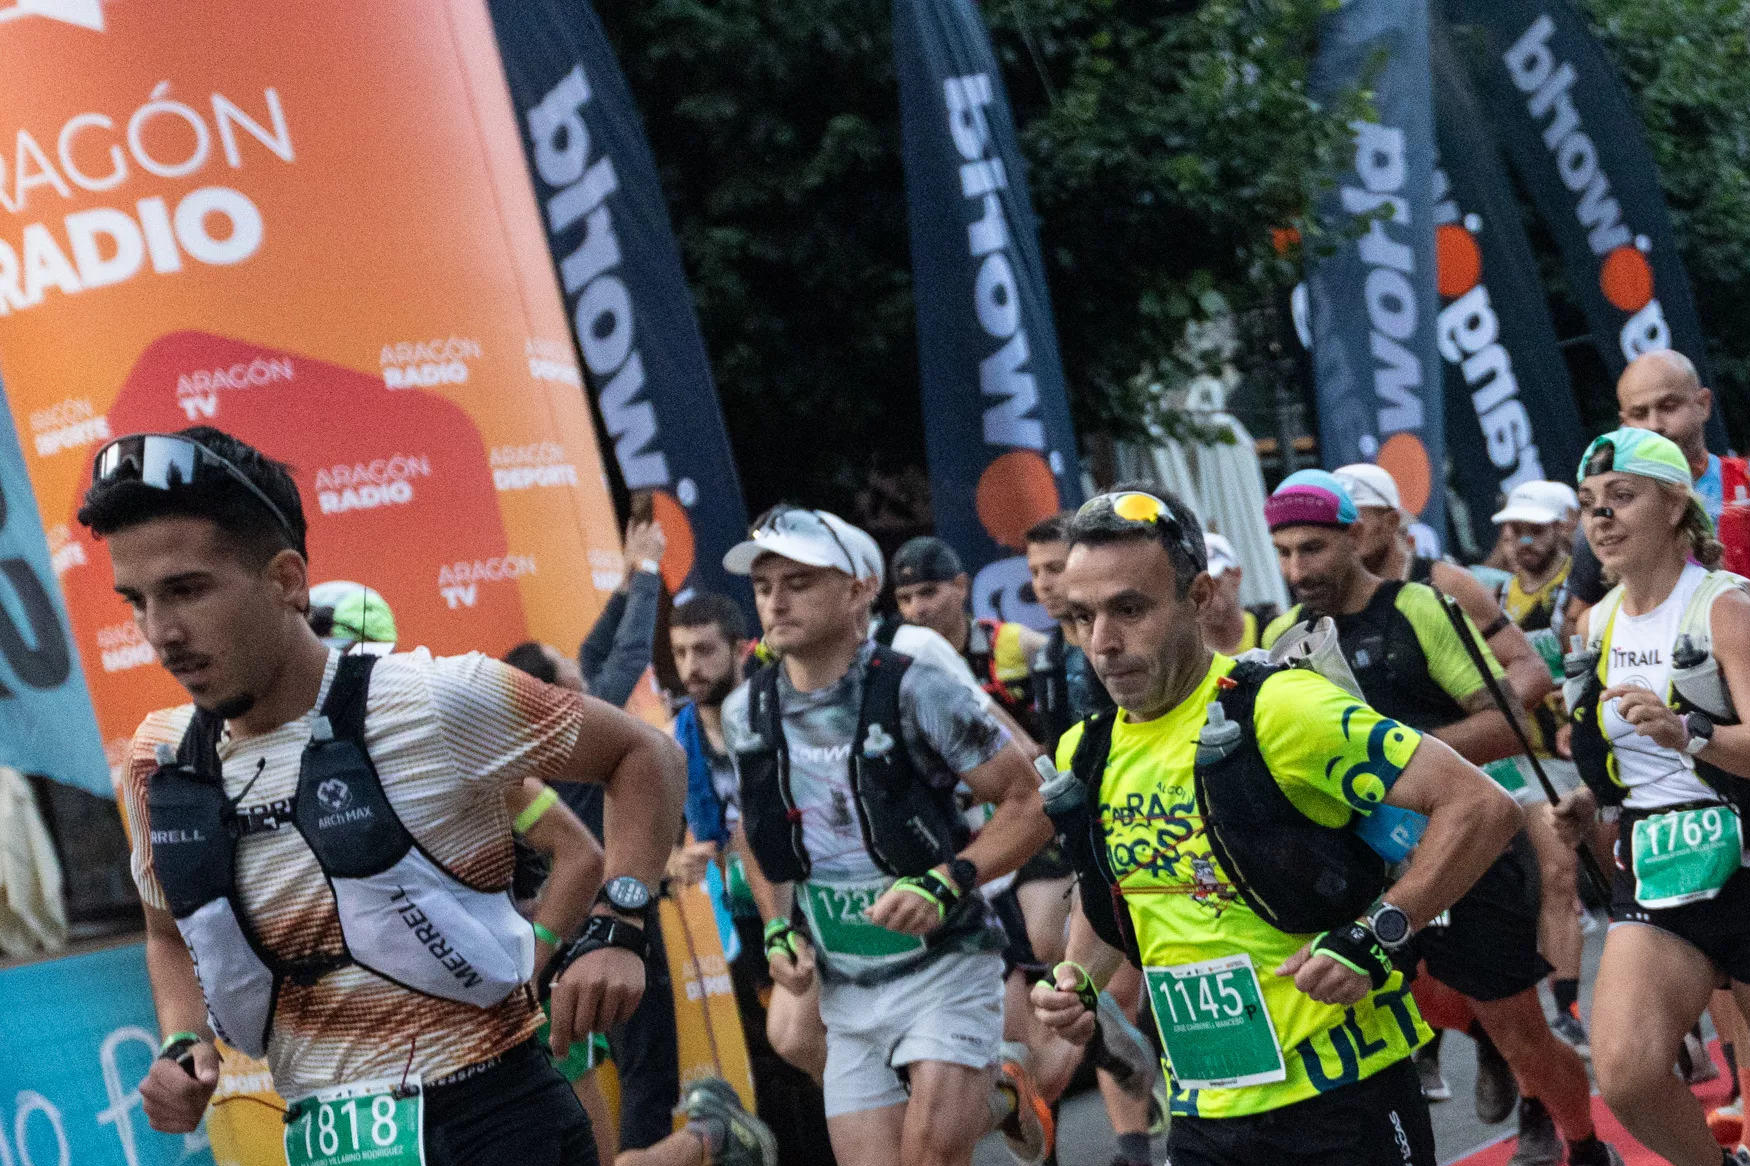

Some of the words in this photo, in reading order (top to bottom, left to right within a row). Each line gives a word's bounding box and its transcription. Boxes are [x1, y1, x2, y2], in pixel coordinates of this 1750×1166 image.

[0, 79, 297, 214] AGÓN
[150, 828, 206, 845] RRELL
[1646, 808, 1724, 856] 1769
[818, 884, 884, 921] 123
[389, 884, 483, 989] MERRELL
[1159, 971, 1245, 1024] 1145
